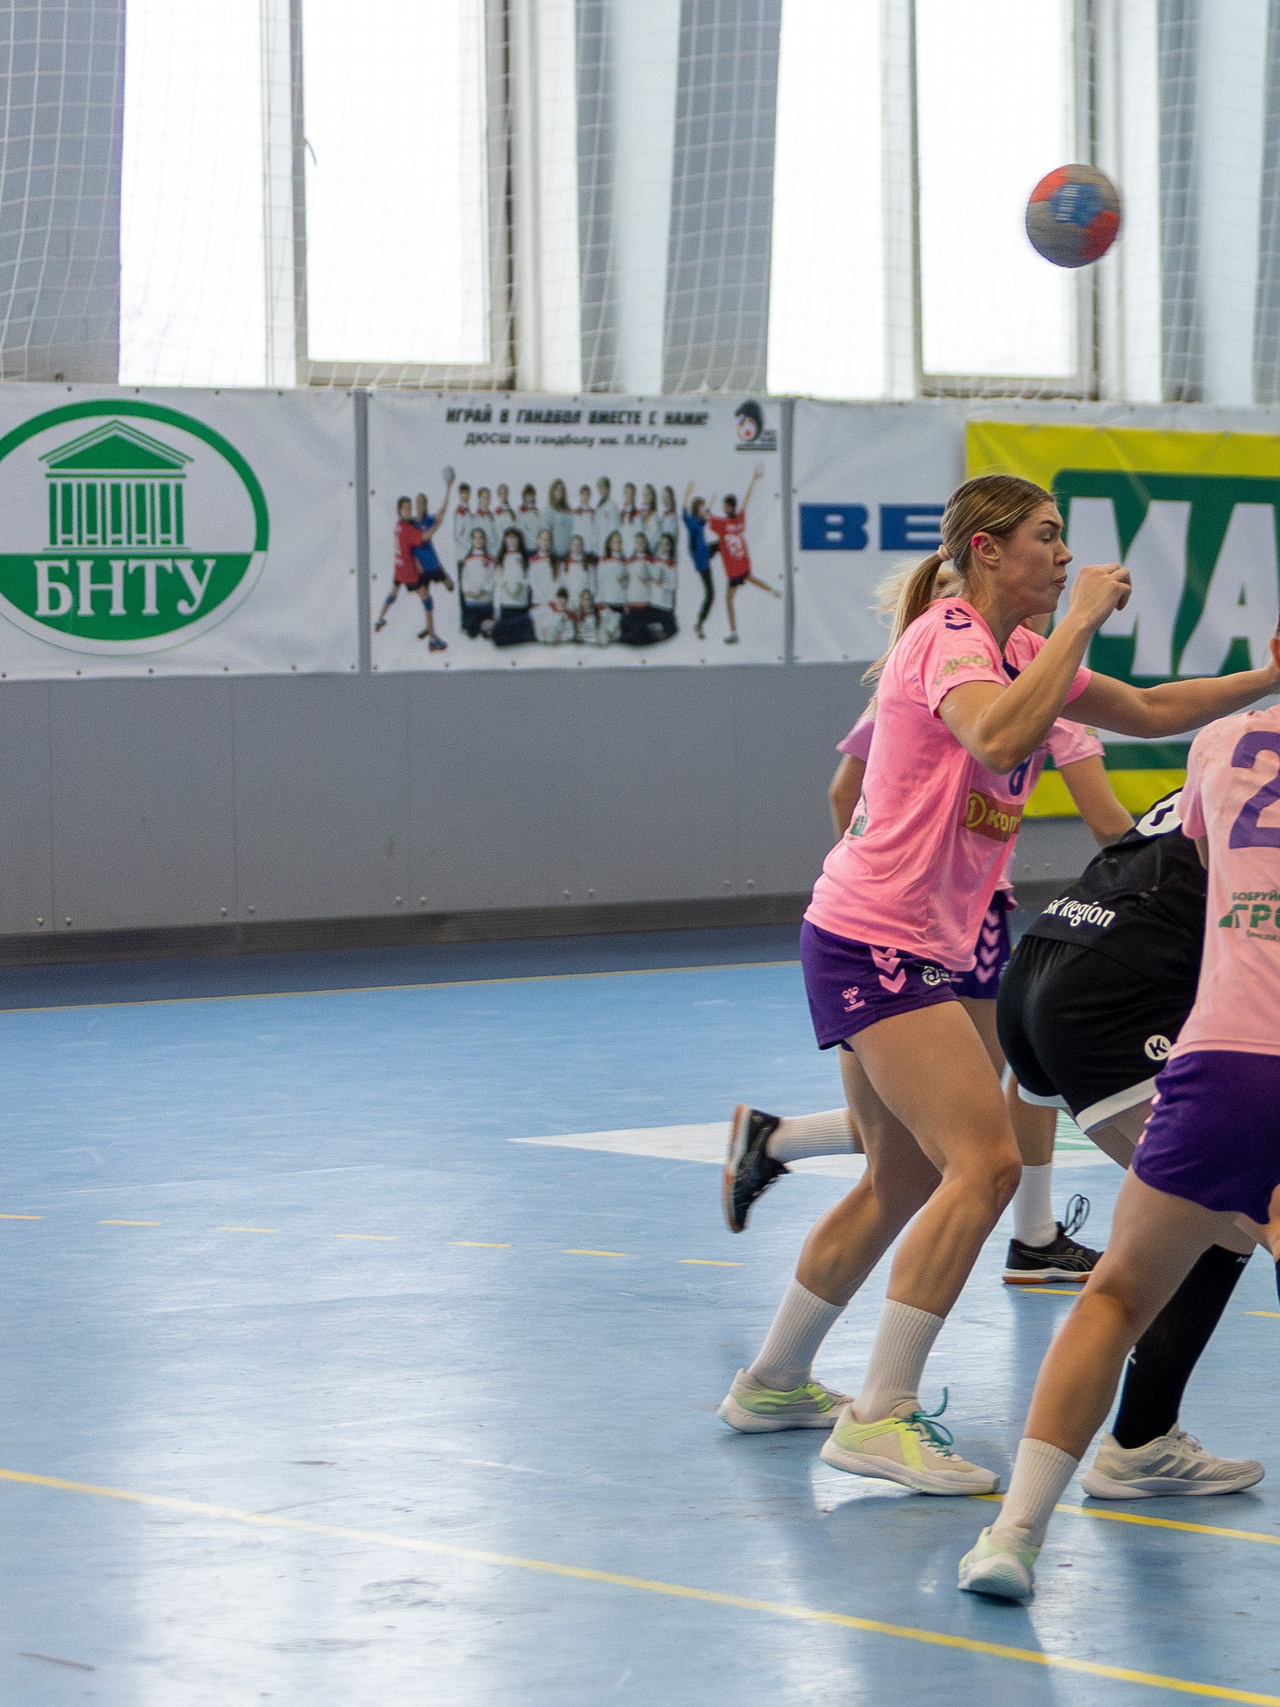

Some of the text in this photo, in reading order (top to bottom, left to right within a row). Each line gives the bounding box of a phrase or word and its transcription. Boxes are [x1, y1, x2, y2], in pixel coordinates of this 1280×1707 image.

[446, 403, 492, 423] ИГРАЙ
[500, 409, 509, 423] В
[34, 558, 217, 617] БНТУ
